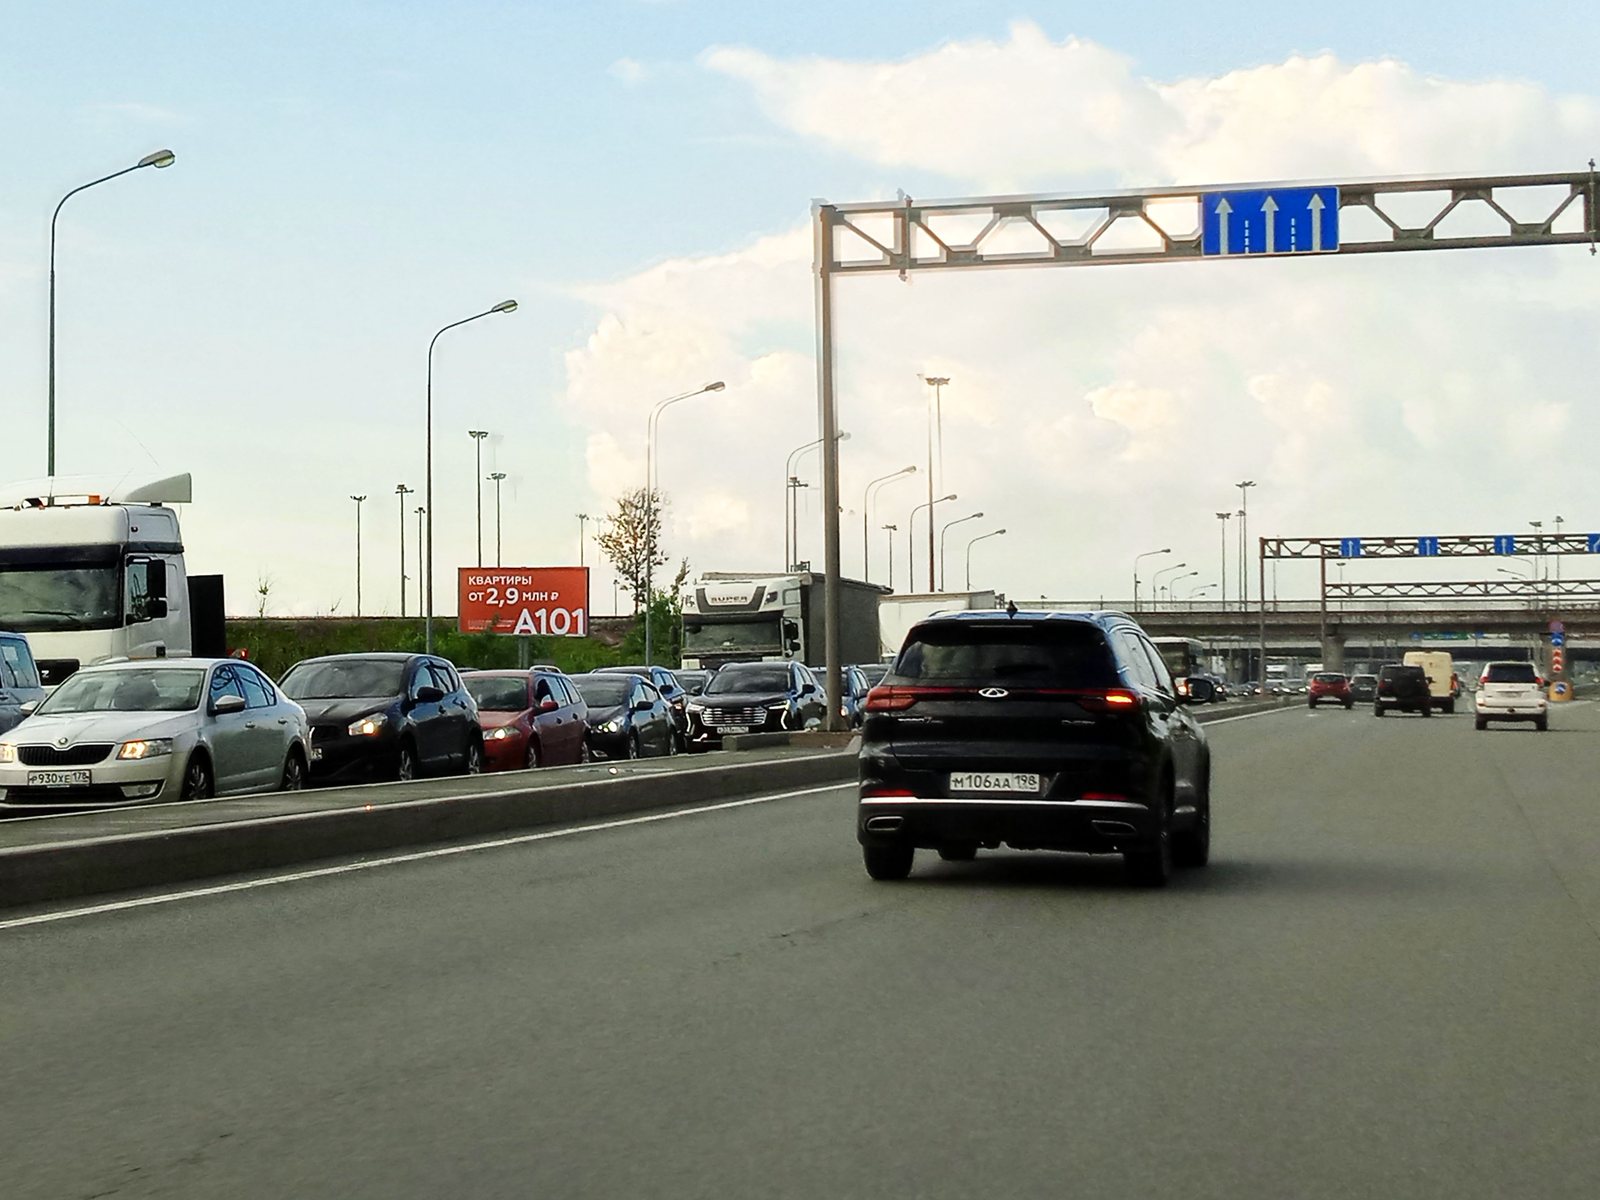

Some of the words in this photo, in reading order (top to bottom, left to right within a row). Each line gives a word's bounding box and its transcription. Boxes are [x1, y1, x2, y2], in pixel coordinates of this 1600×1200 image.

[468, 576, 532, 585] КВАРТИРЫ
[486, 587, 519, 607] 2,9
[522, 592, 548, 601] МЛН
[513, 608, 584, 635] A101
